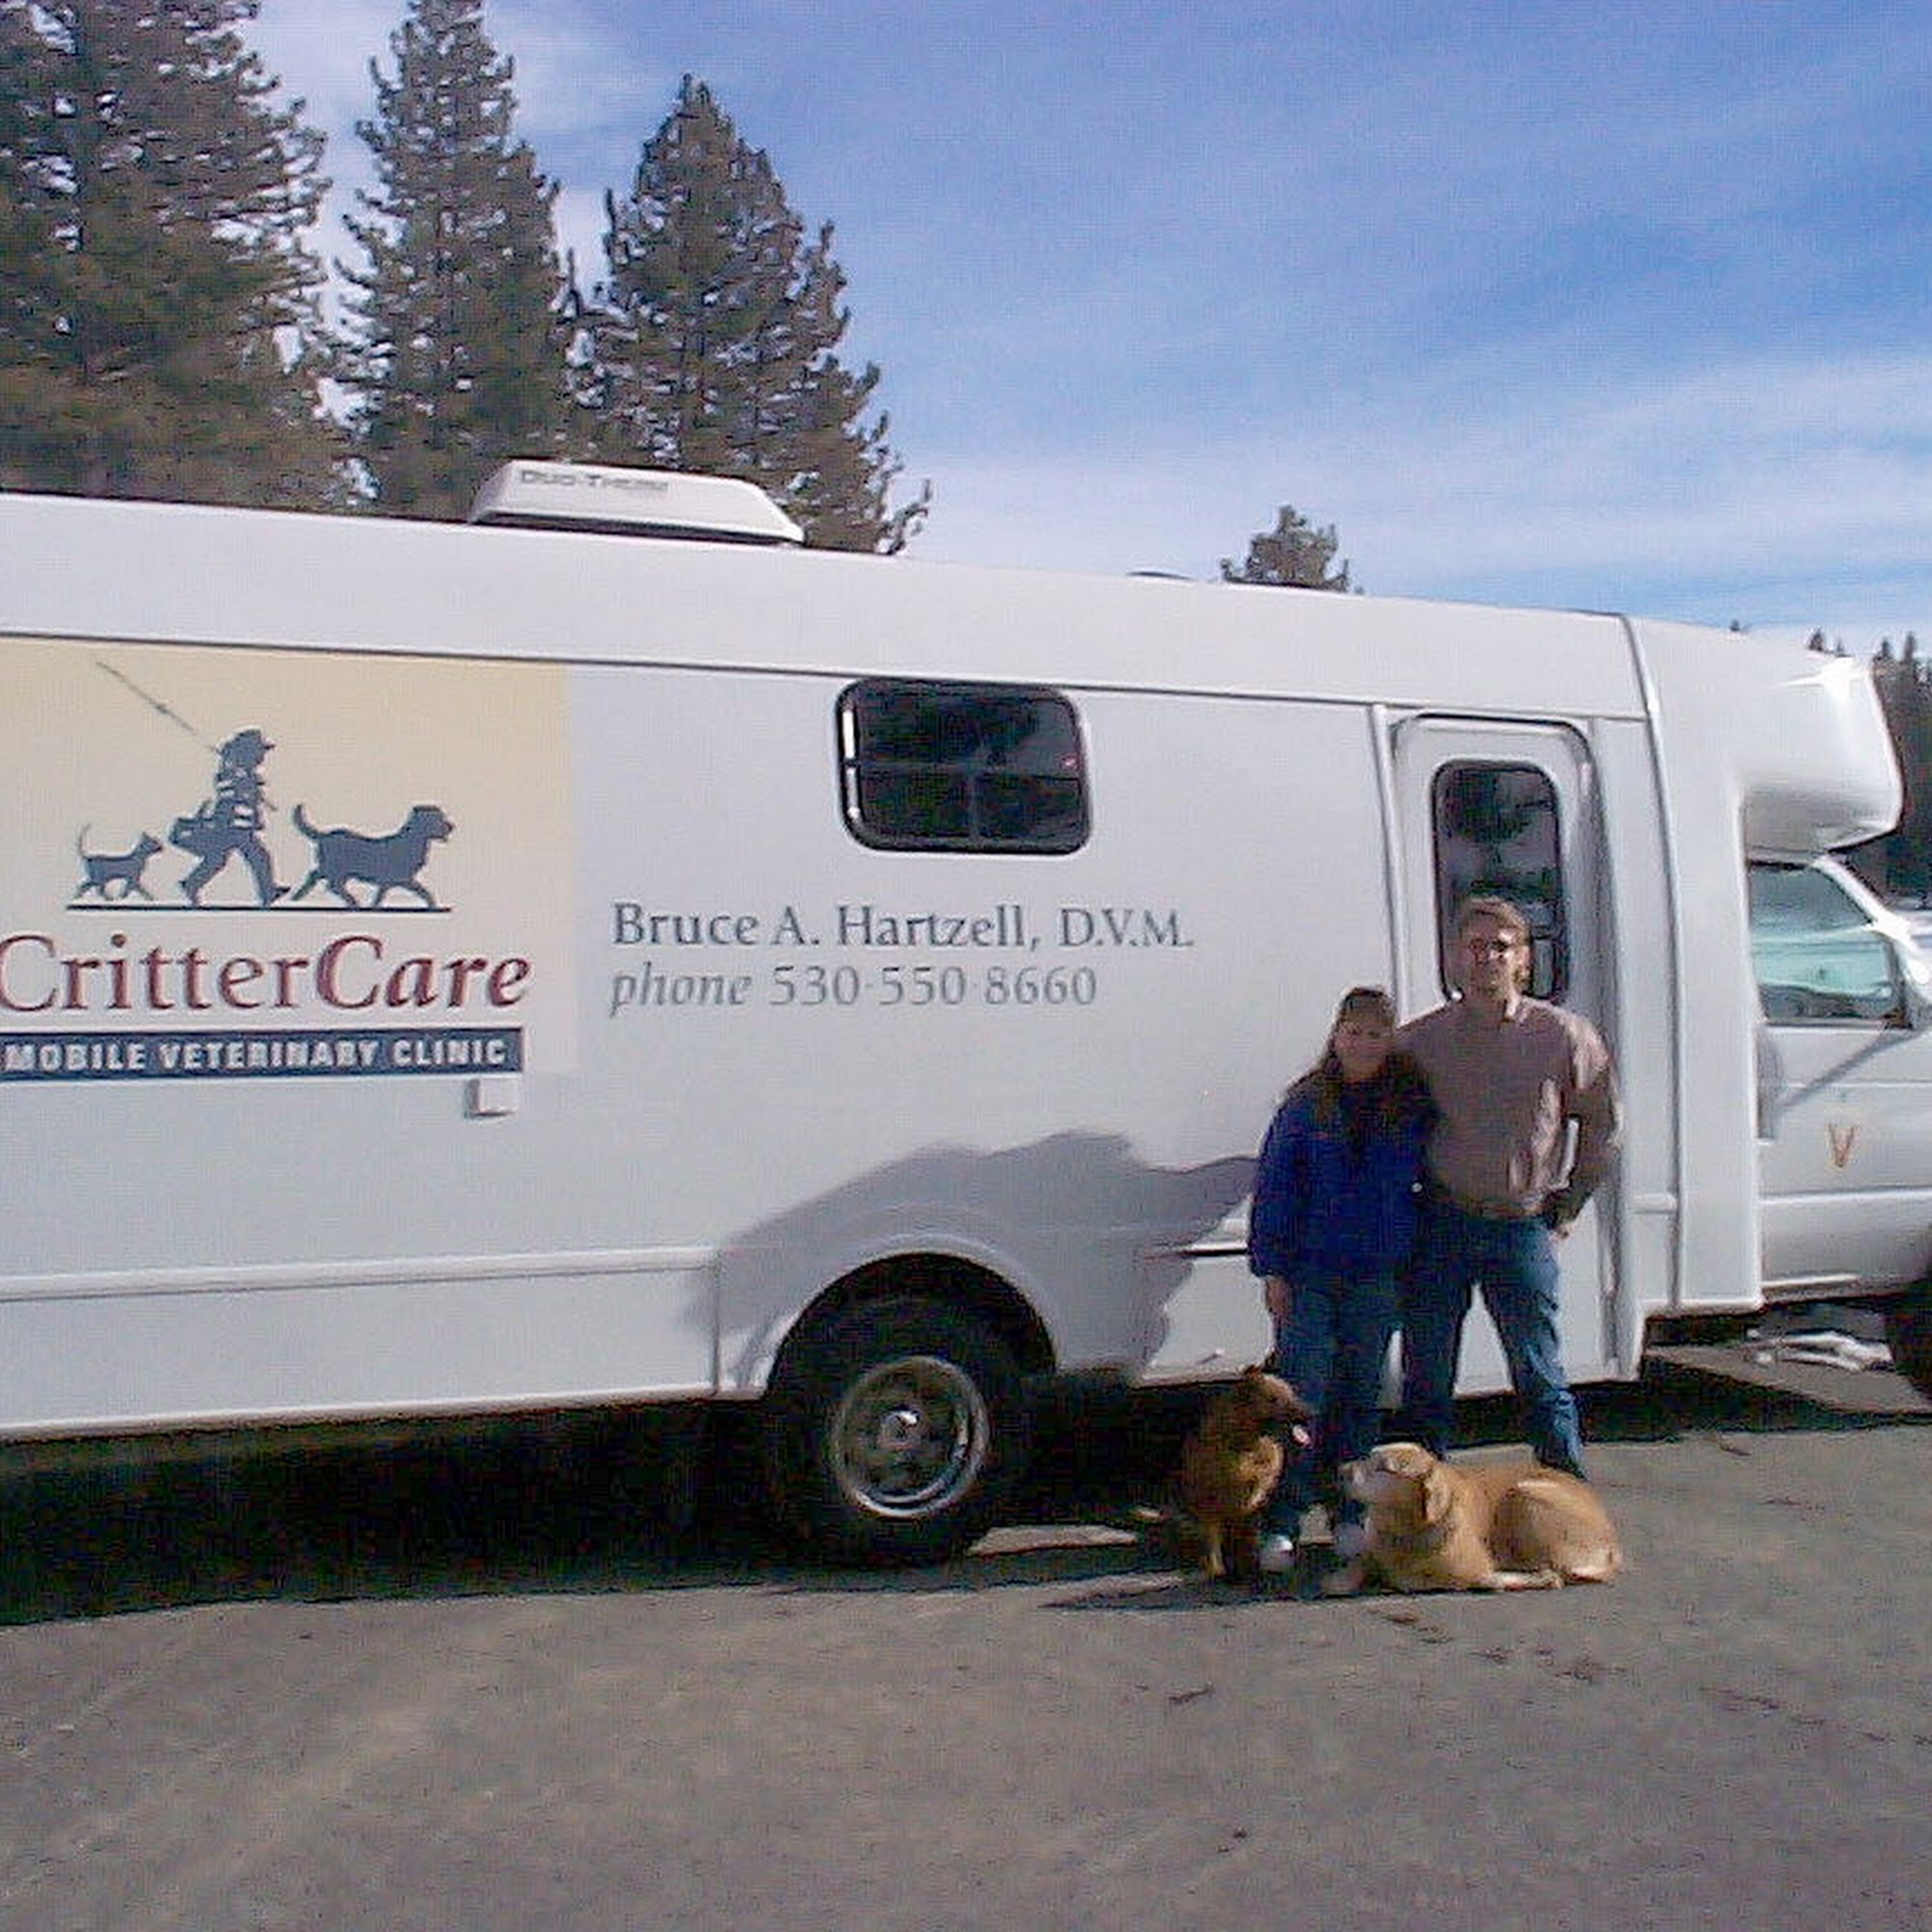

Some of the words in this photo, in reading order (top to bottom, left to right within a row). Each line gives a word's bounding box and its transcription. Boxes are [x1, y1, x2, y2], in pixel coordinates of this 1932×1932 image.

[611, 901, 759, 946] Bruce
[773, 906, 820, 945] A.
[837, 904, 1040, 951] Hartzell,
[1060, 907, 1195, 947] D.V.M.
[0, 934, 531, 1012] CritterCare
[610, 963, 753, 1018] phone
[4, 1042, 146, 1072] MOBILE
[160, 1040, 379, 1069] VETERINARY
[393, 1037, 505, 1065] CLINIC
